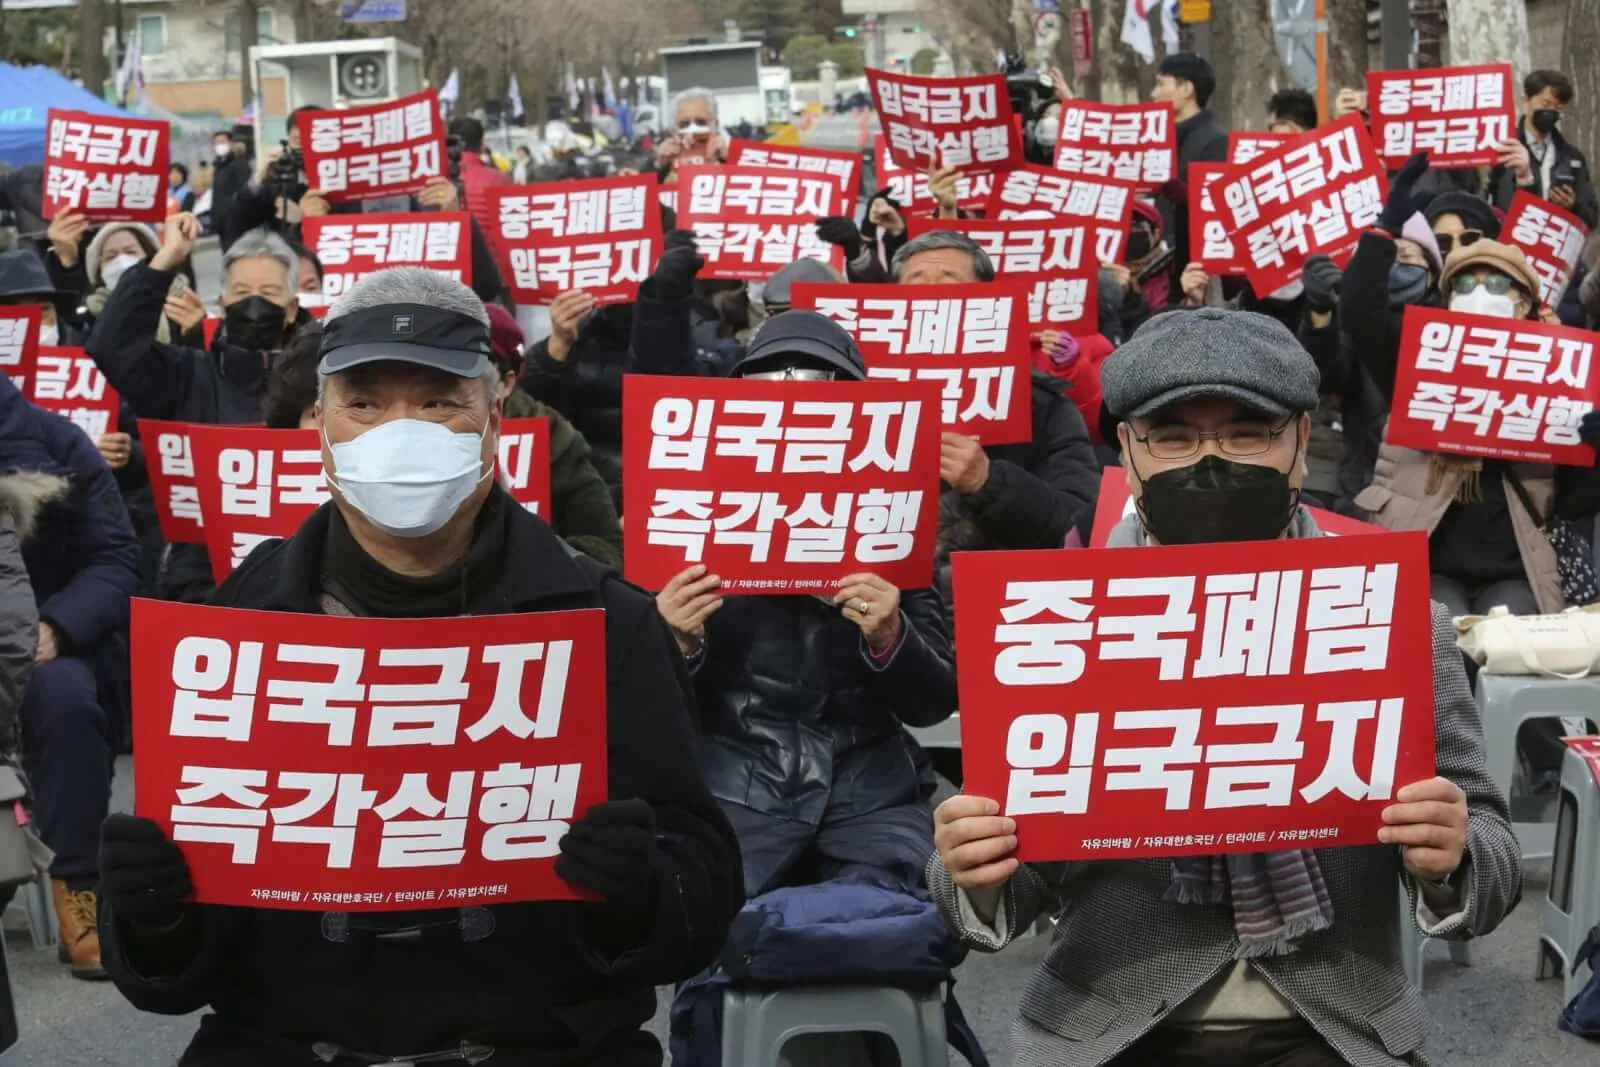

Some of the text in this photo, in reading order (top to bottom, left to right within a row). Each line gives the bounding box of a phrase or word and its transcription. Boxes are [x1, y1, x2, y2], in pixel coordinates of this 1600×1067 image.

[877, 79, 998, 124] 입국금지
[1061, 107, 1168, 145] 입국금지
[48, 118, 160, 167] 입국금지
[888, 120, 1009, 166] 즉각실행
[1384, 114, 1509, 157] 입국금지
[47, 164, 160, 209] 즉각실행
[317, 140, 440, 192] 입국금지
[1056, 147, 1172, 182] 즉각실행
[1223, 126, 1364, 229] 입국금지
[499, 185, 647, 239] 중국폐렴
[688, 174, 833, 217] 입국금지
[316, 221, 461, 265] 중국폐렴
[1247, 175, 1384, 269] 즉각실행
[510, 239, 652, 290] 입국금지
[960, 226, 1085, 273] 국금지
[1415, 321, 1593, 389] 입국금지
[648, 397, 921, 474] 입국금지
[1408, 381, 1593, 446] 즉각실행
[647, 488, 922, 563] 즉각실행
[993, 562, 1400, 686] 중국폐렴
[169, 635, 574, 747] 입국금지
[1004, 696, 1405, 816] 입국금지
[169, 762, 582, 869] 즉각실행
[1081, 835, 1132, 849] 자유의바람
[1143, 832, 1215, 848] 자유대한호국단
[1226, 830, 1266, 844] 턴라이트
[1277, 827, 1339, 841] 자유법치센터
[251, 888, 301, 902] 자유의바람
[311, 892, 384, 904] 자유대한호국단
[395, 889, 436, 902] 턴라이트
[446, 883, 508, 899] 자유법치센터
